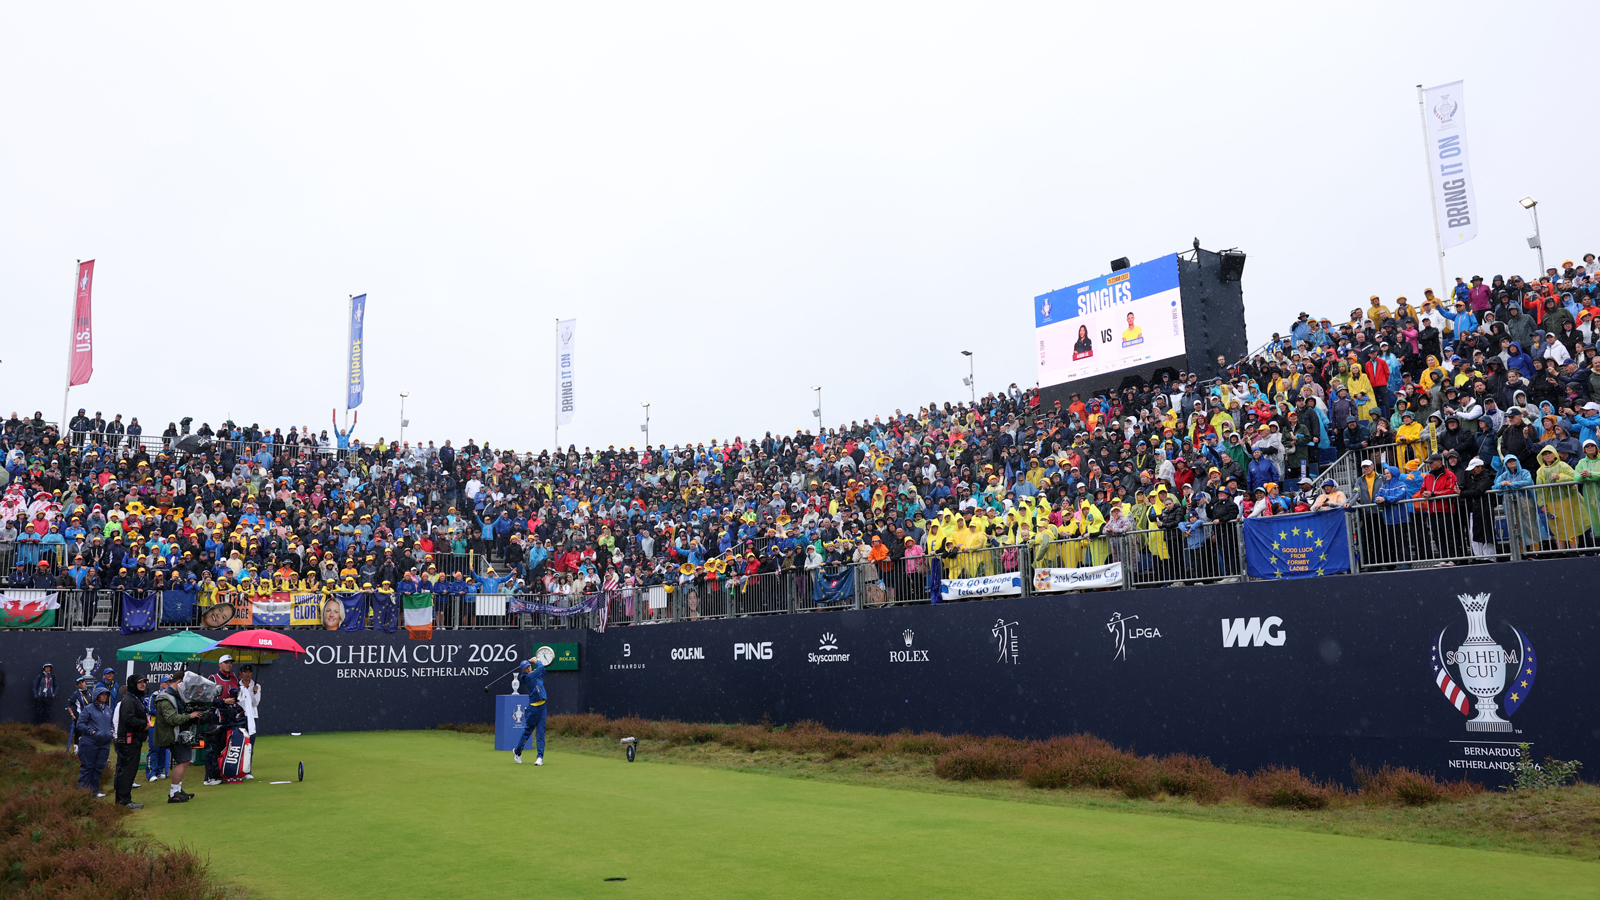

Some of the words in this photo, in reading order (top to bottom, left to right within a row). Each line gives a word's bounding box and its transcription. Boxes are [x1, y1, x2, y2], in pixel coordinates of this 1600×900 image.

[1438, 135, 1461, 160] ON
[1441, 162, 1464, 177] IT
[1442, 178, 1471, 228] BRING
[1077, 281, 1132, 317] SINGLES
[76, 327, 91, 352] U.S.
[1101, 328, 1112, 343] VS
[561, 353, 571, 368] ON
[561, 371, 572, 379] IT
[561, 381, 573, 412] BRING
[1053, 573, 1070, 583] 20th
[1070, 571, 1102, 584] Solheim
[1104, 568, 1120, 582] Cup
[966, 579, 980, 588] GO
[976, 586, 989, 595] GO
[1129, 627, 1162, 639] LPGA
[258, 638, 273, 646] USA
[304, 644, 408, 664] SOLHEIM
[467, 643, 518, 662] 2026
[671, 647, 705, 660] GOLF.NL
[734, 641, 773, 661] PING
[889, 650, 930, 662] ROLEX
[1446, 650, 1518, 665] SOLHEIM
[808, 652, 850, 665] Skyscanner
[150, 662, 172, 671] YARDS
[336, 668, 409, 679] BERNARDUS,
[411, 666, 489, 677] NETHERLANDS
[1466, 665, 1498, 678] CUP
[147, 673, 174, 684] METS
[226, 746, 241, 764] USA
[1464, 747, 1521, 757] BERNARDUS
[1448, 759, 1515, 771] NETHERLANDS
[1516, 762, 1541, 771] 26
